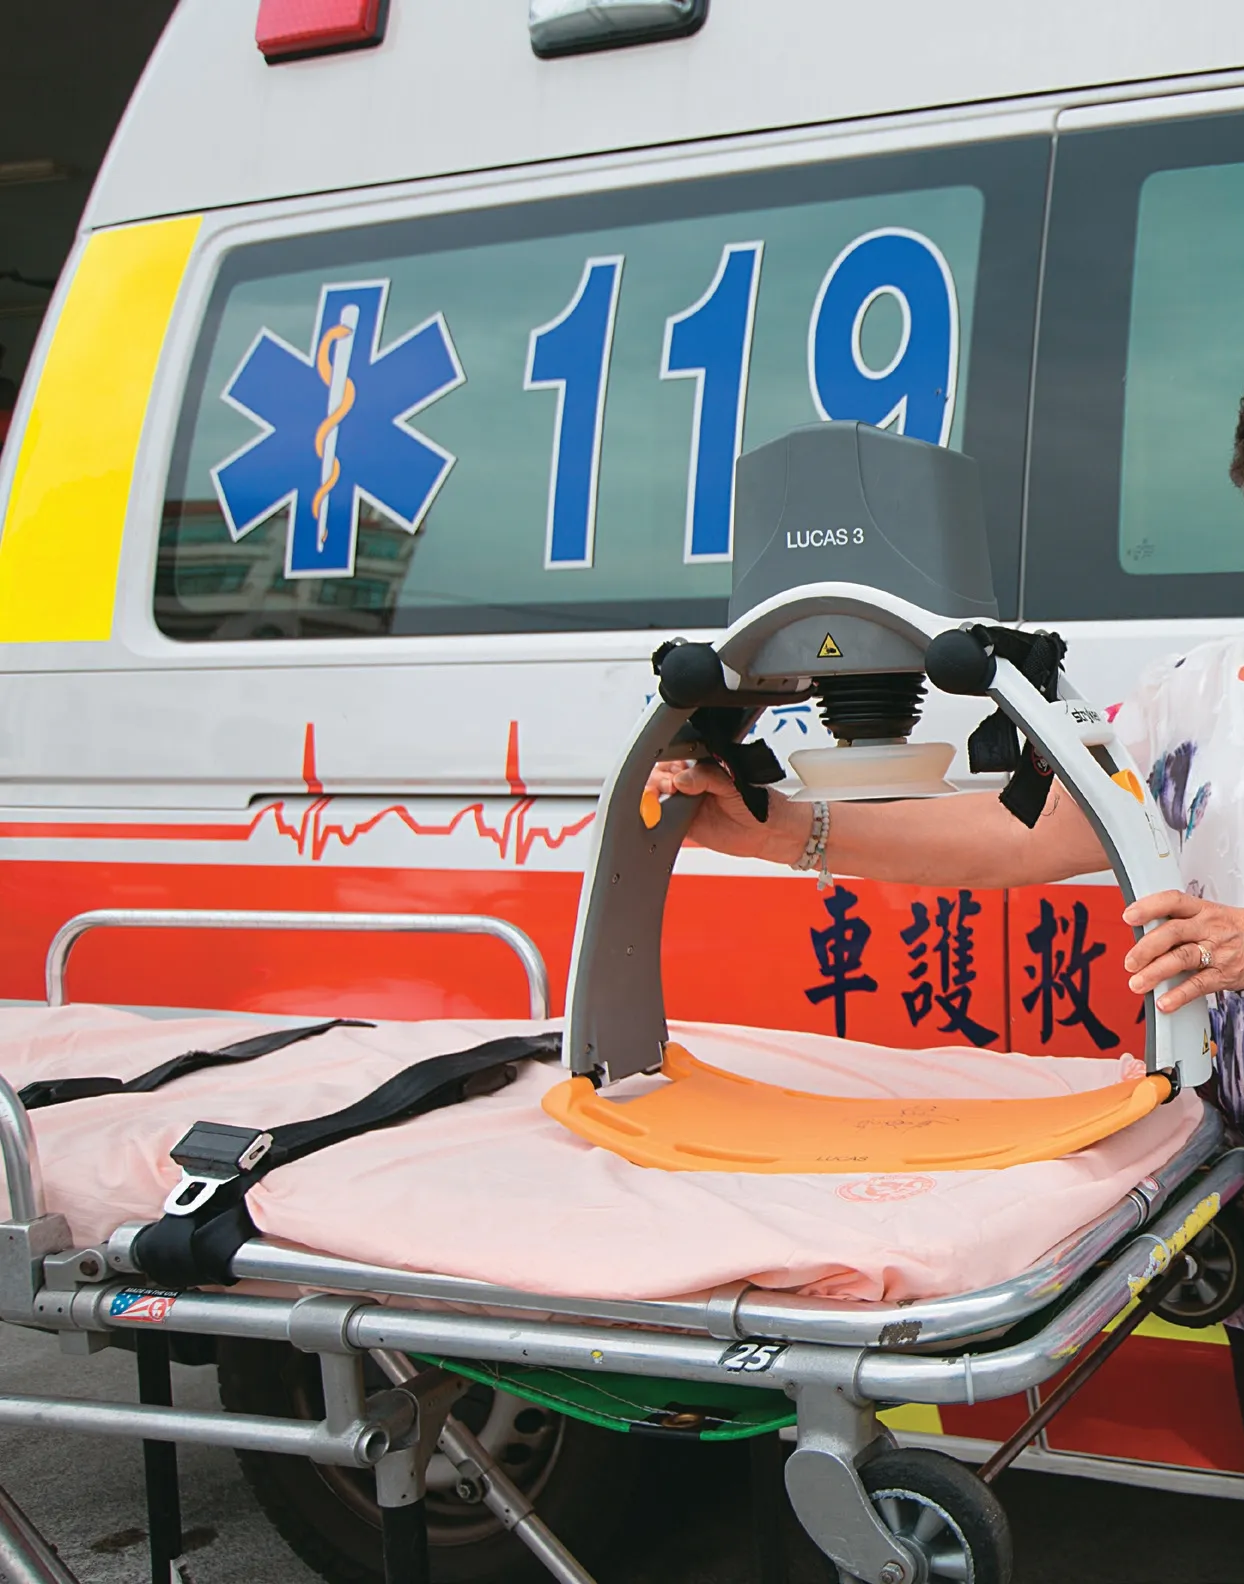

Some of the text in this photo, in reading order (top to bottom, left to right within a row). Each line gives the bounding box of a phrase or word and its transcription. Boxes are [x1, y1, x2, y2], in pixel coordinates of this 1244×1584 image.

[524, 226, 960, 570] 119
[786, 527, 865, 549] LUCAS 3
[723, 1343, 780, 1371] 25
